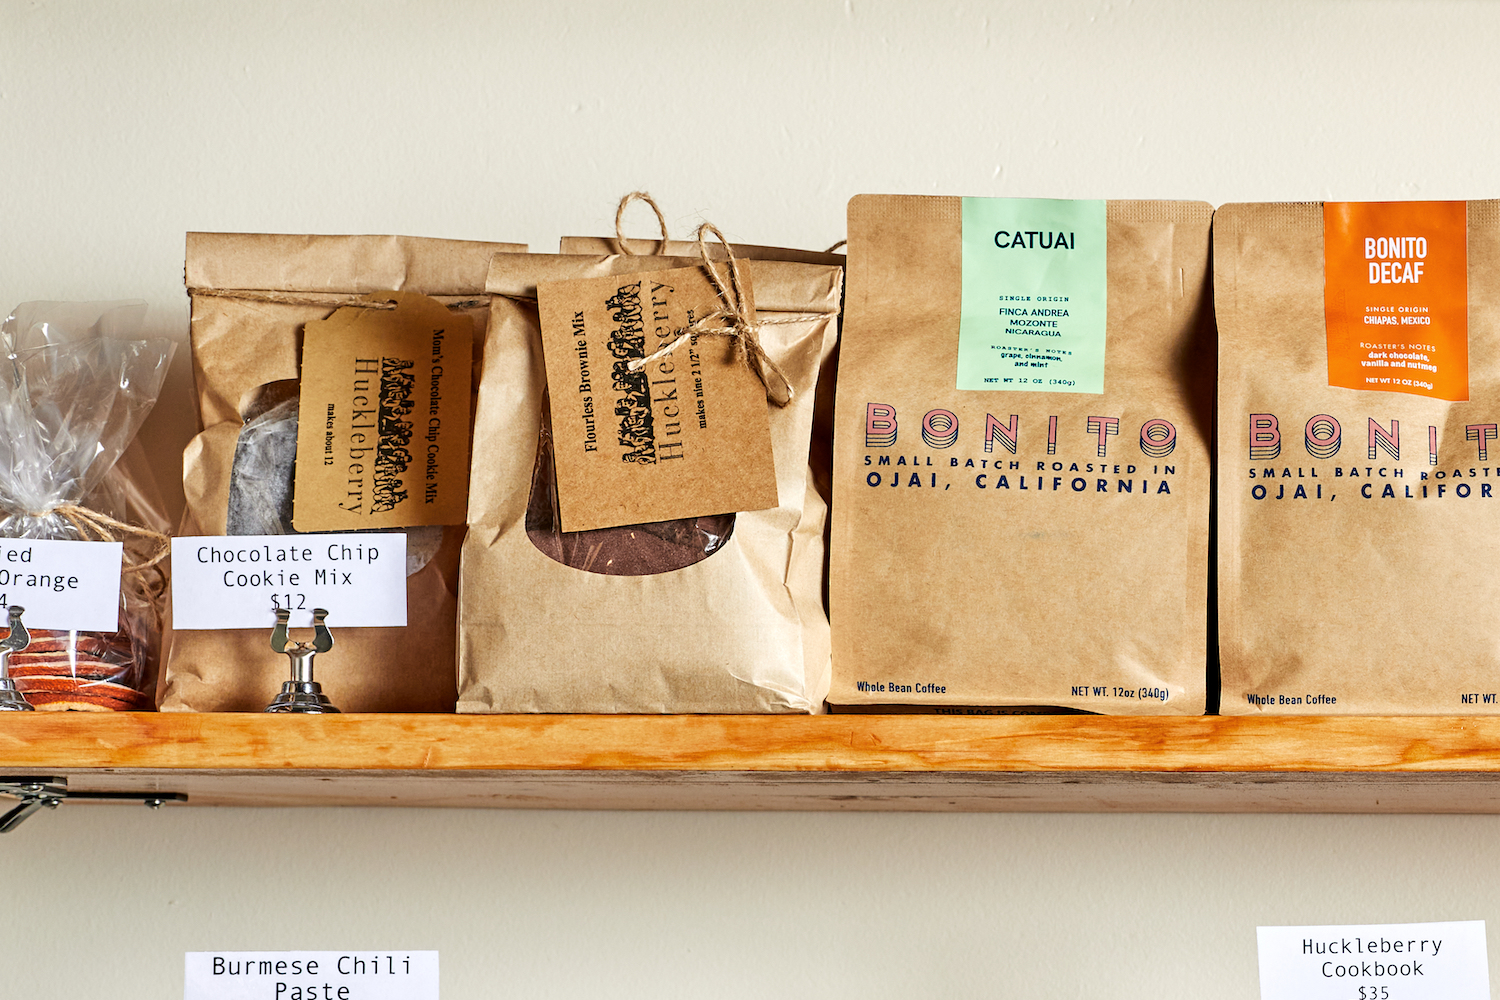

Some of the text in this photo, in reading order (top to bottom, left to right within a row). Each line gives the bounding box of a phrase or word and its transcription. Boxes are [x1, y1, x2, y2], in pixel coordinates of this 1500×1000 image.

[993, 230, 1076, 251] CATUAI
[1364, 236, 1428, 260] BONITO
[1368, 261, 1425, 285] DECAF
[999, 307, 1070, 317] FINCA ANDREA
[1004, 328, 1062, 338] NICARAGUA
[1009, 319, 1058, 328] MOZONTE
[429, 365, 444, 416] Chocolate
[571, 310, 598, 453] Flourless Brownie Mix
[323, 403, 337, 466] makes about 12
[337, 356, 380, 516] Huckleberry
[424, 416, 442, 443] Chip
[865, 402, 1177, 459] BONITO
[426, 444, 440, 481] Cookie
[864, 455, 1177, 475] SMALL BATCH ROASTED IN
[424, 482, 438, 504] Mix
[866, 472, 1171, 495] OJAI, CALIFORNIA
[196, 543, 381, 568] Chocolate Chip
[222, 568, 353, 589] Cookie Mix
[269, 593, 307, 612] $12
[1301, 937, 1443, 959] Huckleberry
[212, 955, 412, 976] Burmese Chili
[1320, 958, 1425, 979] Cookbook
